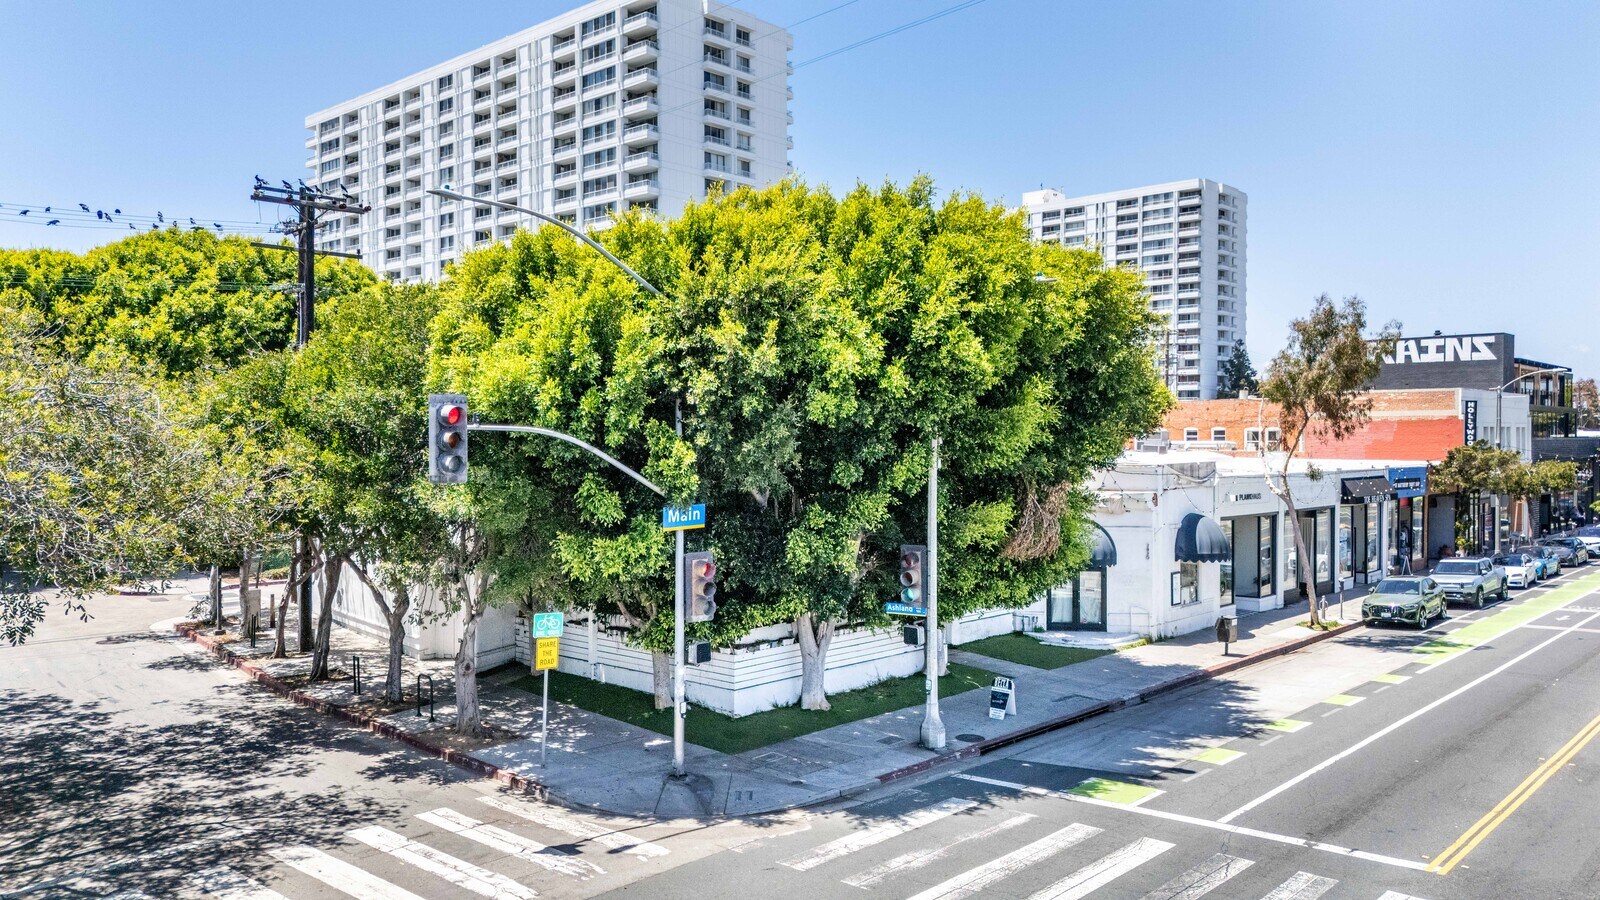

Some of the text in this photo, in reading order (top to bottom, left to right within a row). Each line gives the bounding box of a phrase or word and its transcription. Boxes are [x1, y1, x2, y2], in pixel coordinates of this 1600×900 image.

[1466, 401, 1475, 446] HOLLYWOO
[668, 507, 701, 523] Main
[540, 658, 554, 666] ROAD
